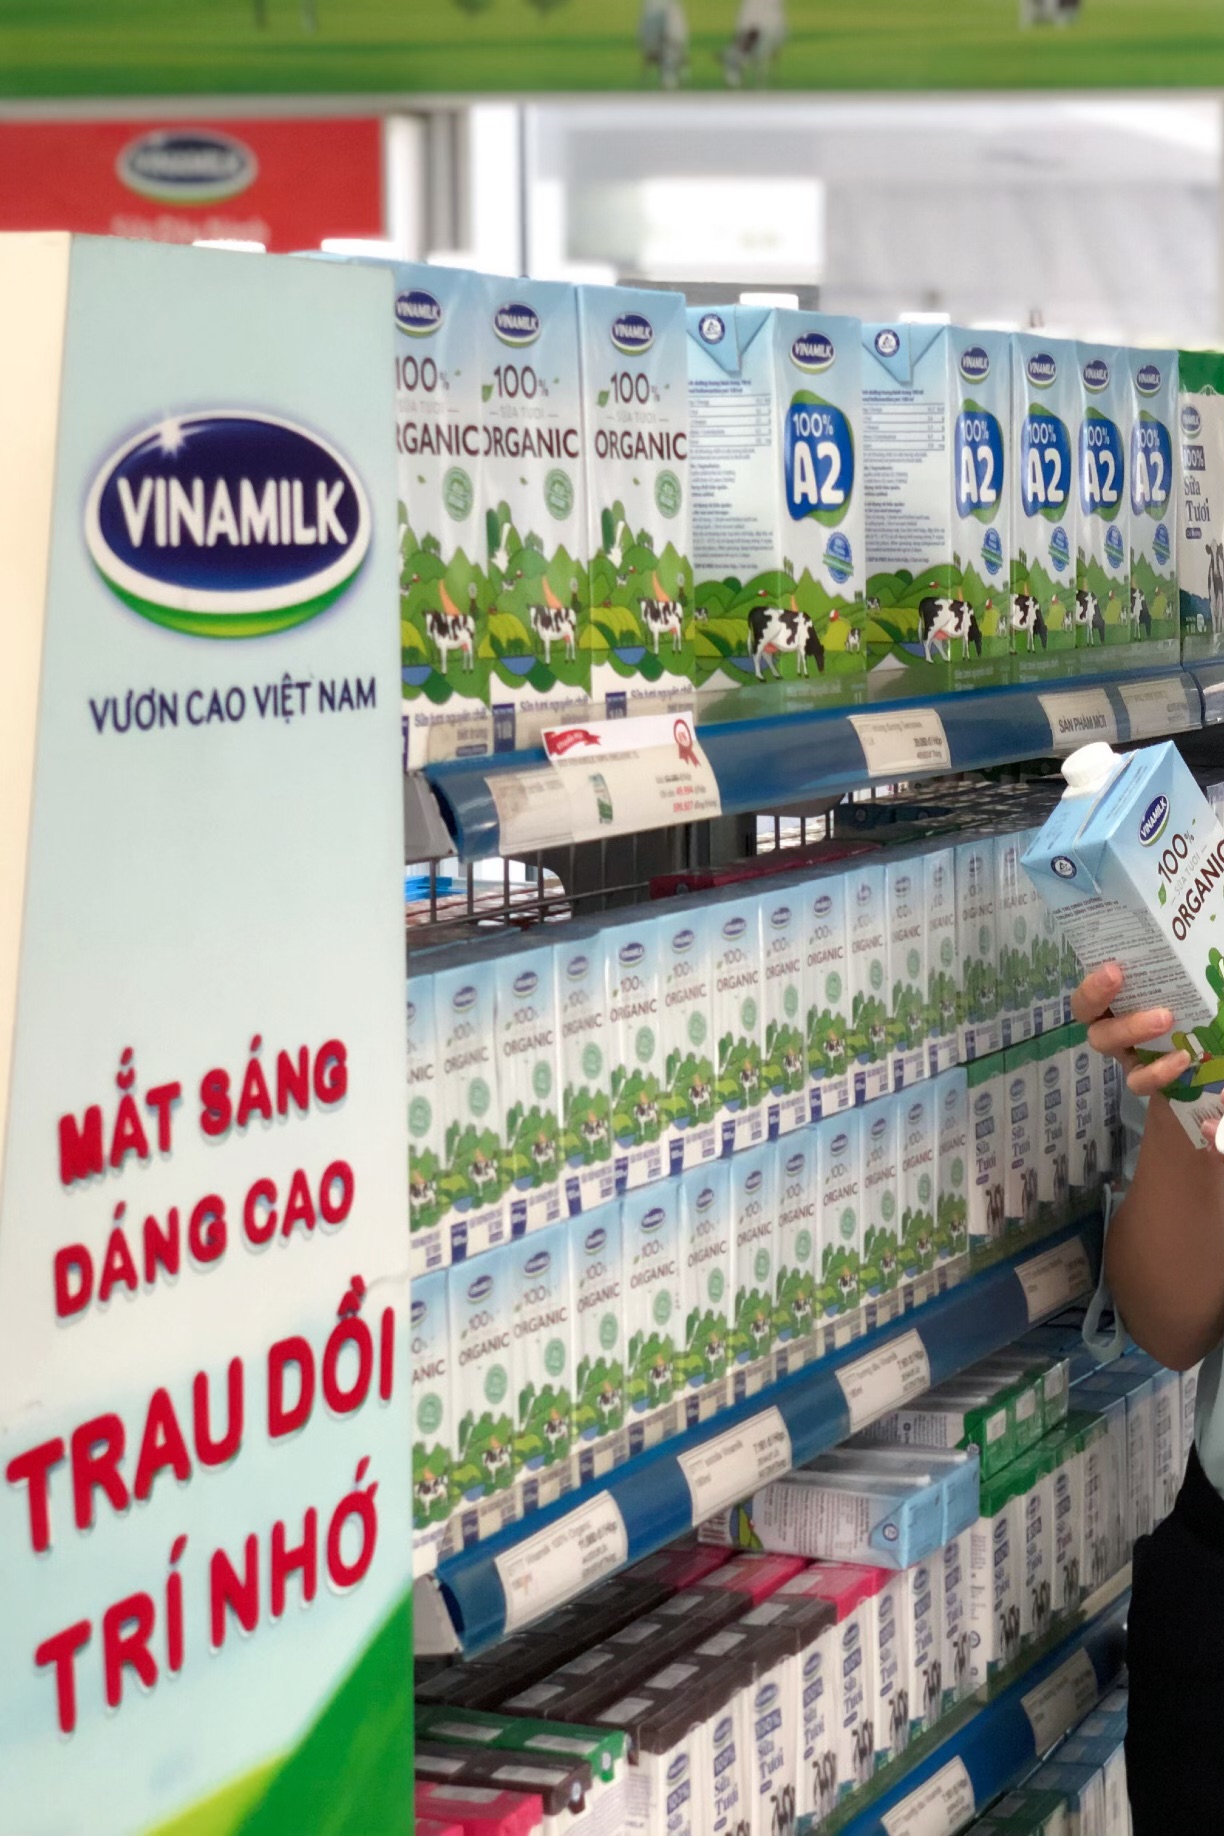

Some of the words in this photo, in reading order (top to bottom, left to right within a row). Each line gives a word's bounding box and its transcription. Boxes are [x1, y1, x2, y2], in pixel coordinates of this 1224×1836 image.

[497, 313, 538, 331] VINAMILK
[615, 323, 651, 341] VINAMILK
[795, 341, 832, 359] VINAMILK
[493, 364, 549, 399] 100%
[611, 372, 660, 404] 100%
[396, 422, 480, 456] GANIC
[595, 429, 688, 461] ORGANIC
[793, 413, 834, 438] 100%
[794, 441, 844, 505] A2
[961, 446, 996, 503] A2
[1028, 448, 1064, 503] A2
[1085, 449, 1118, 503] A2
[1135, 451, 1166, 502] A2
[116, 476, 348, 548] VINAMILK
[1186, 498, 1211, 522] Tươi
[89, 687, 178, 735] VƯƠN
[185, 687, 246, 726] CAO
[253, 672, 311, 724] VIỆT
[318, 676, 377, 713] NAM
[1141, 797, 1167, 838] VINAMILK
[1158, 830, 1195, 884] 100%
[58, 1047, 181, 1185] MẮT
[200, 1034, 348, 1136] SÁNG
[53, 1201, 227, 1318] DÁNG
[243, 1160, 355, 1245] CAO
[6, 1356, 244, 1553] TRAU
[267, 1274, 394, 1439] DỒI
[35, 1533, 188, 1733] TRÍ
[210, 1455, 378, 1648] NHỚ
